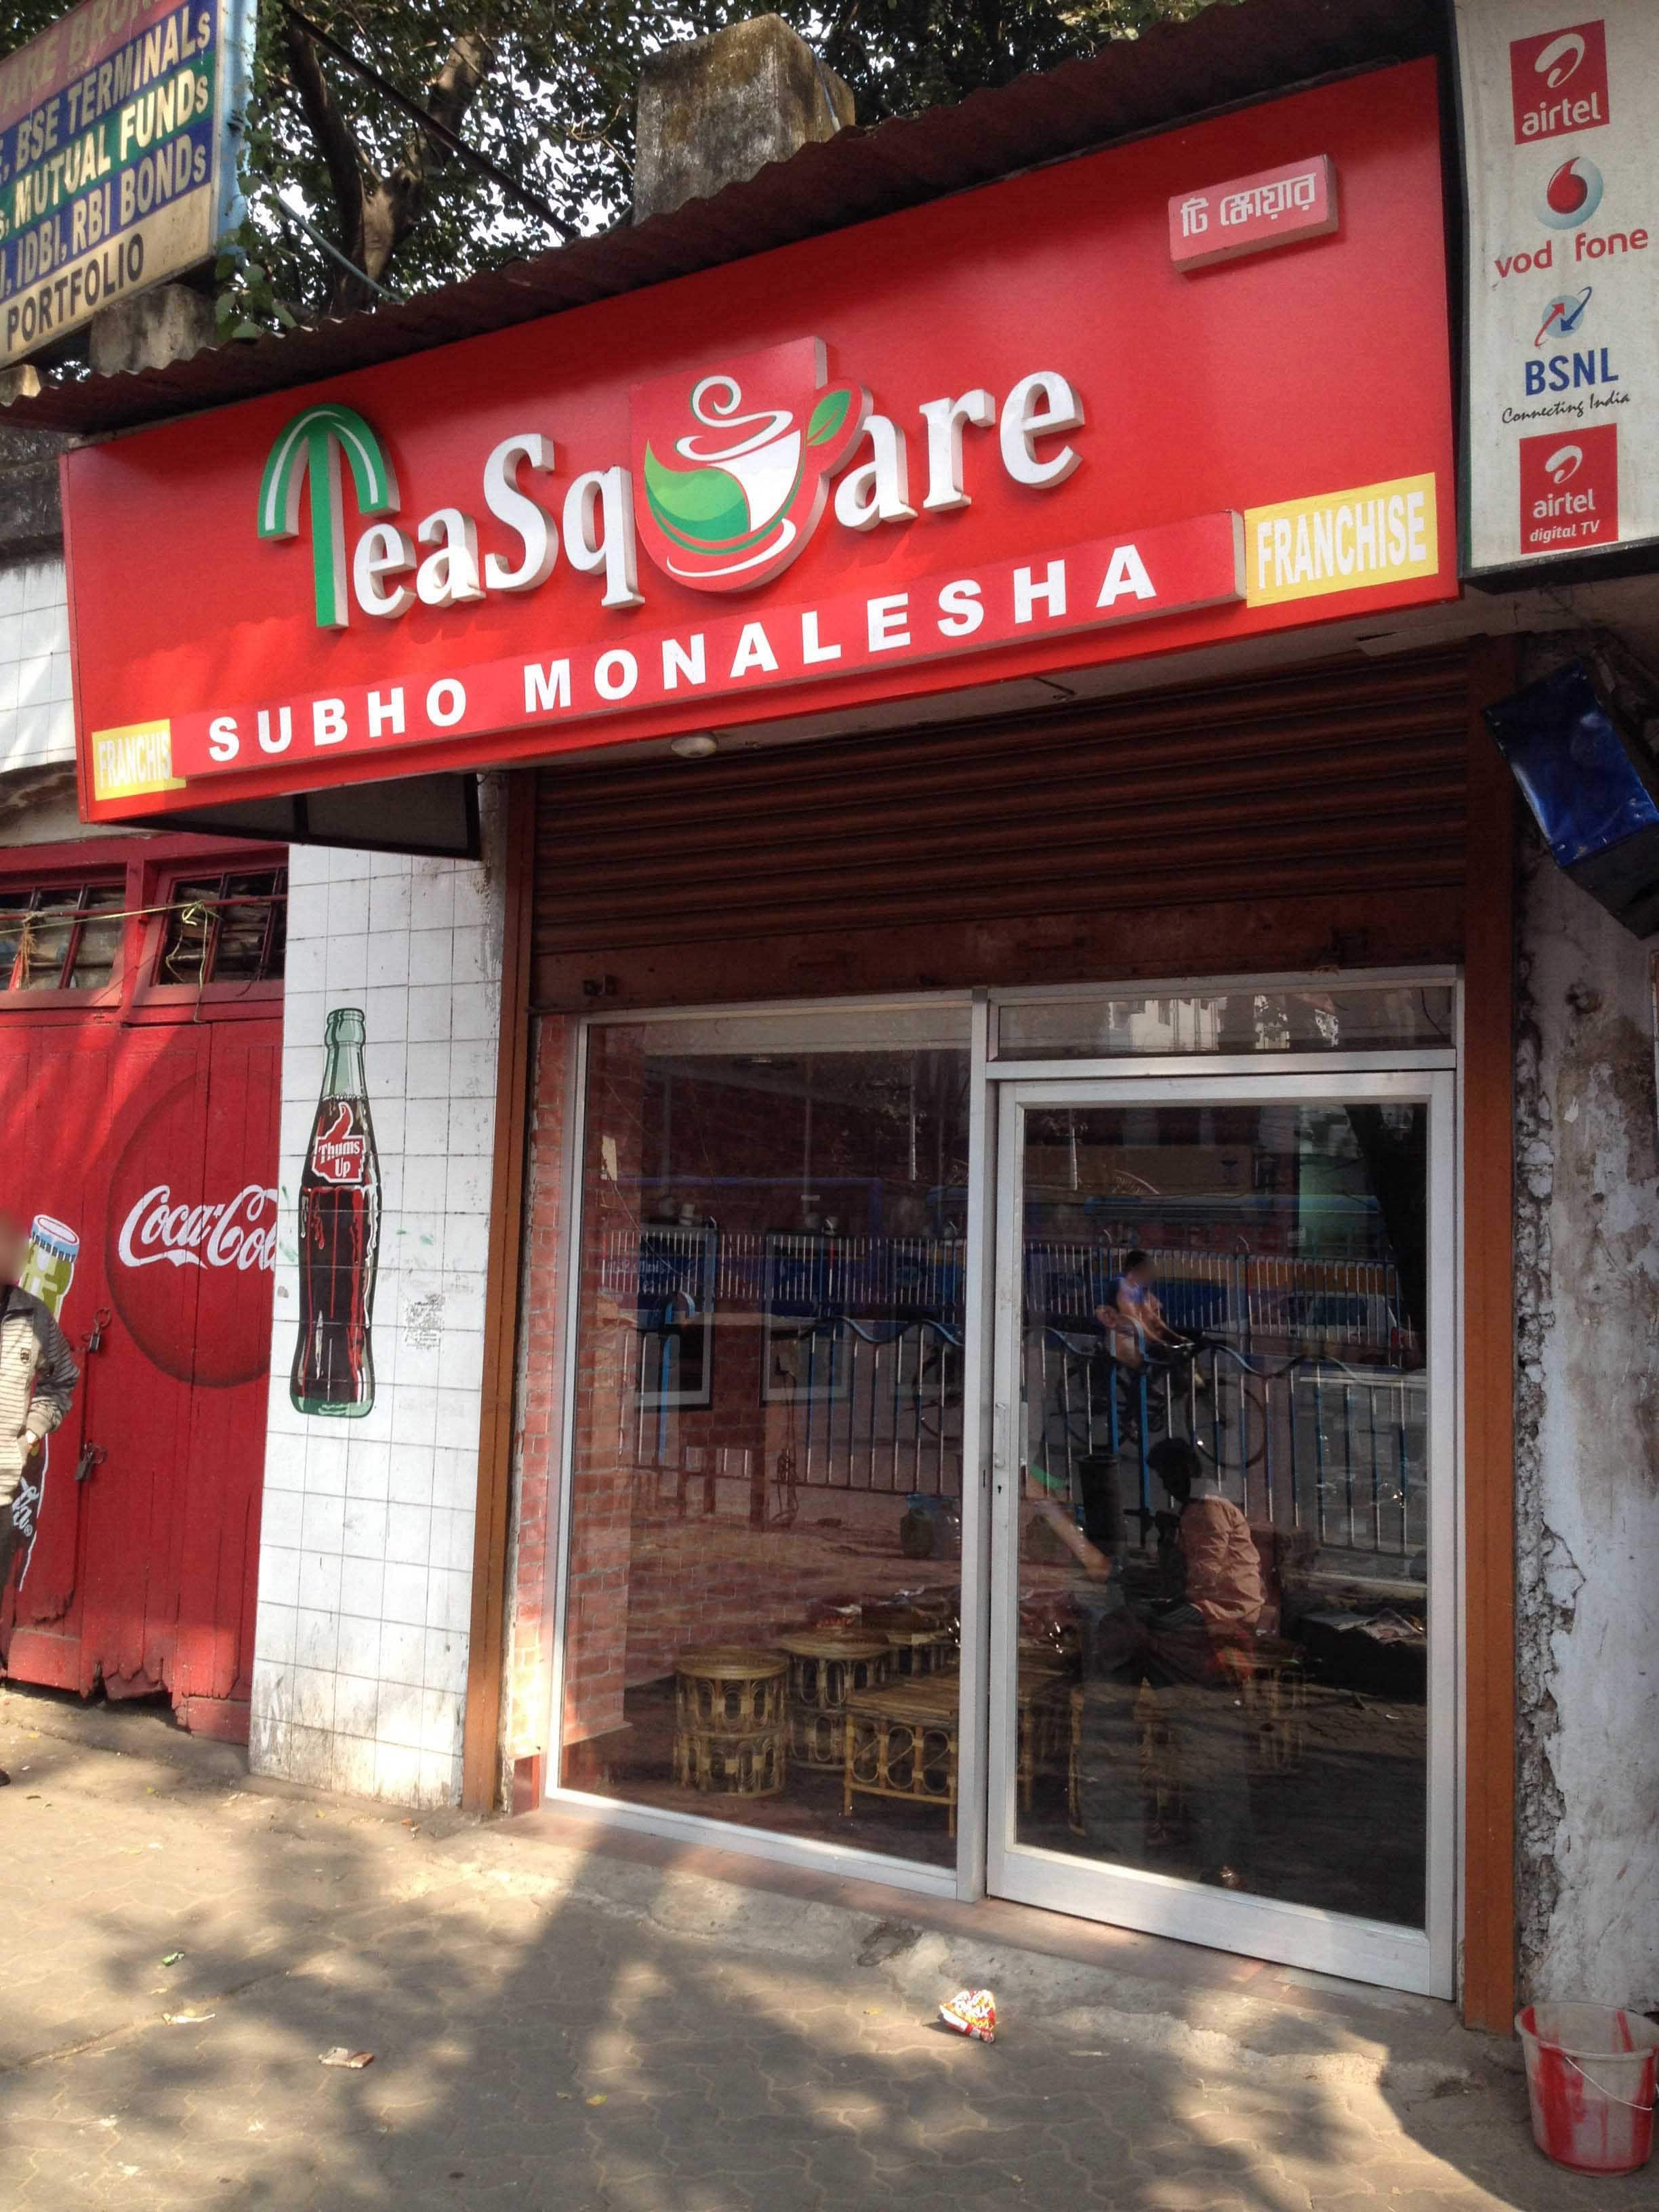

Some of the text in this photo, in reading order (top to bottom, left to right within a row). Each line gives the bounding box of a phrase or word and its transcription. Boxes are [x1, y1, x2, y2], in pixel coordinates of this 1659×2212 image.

[16, 98, 60, 171] BSE
[1521, 91, 1601, 136] airtel
[15, 125, 111, 228] MUTUAL
[72, 182, 111, 255] RBI
[7, 233, 144, 352] PORTFOLIO
[1524, 347, 1620, 396] BSNL
[1501, 390, 1631, 424] Connecting India
[1532, 488, 1597, 519] airtel
[1256, 491, 1428, 590] FRANCHISE
[1529, 519, 1601, 544] digital TV
[208, 544, 1158, 762] SUBHO MONALESHA
[319, 1140, 361, 1165] Thums
[335, 1156, 351, 1179] Up
